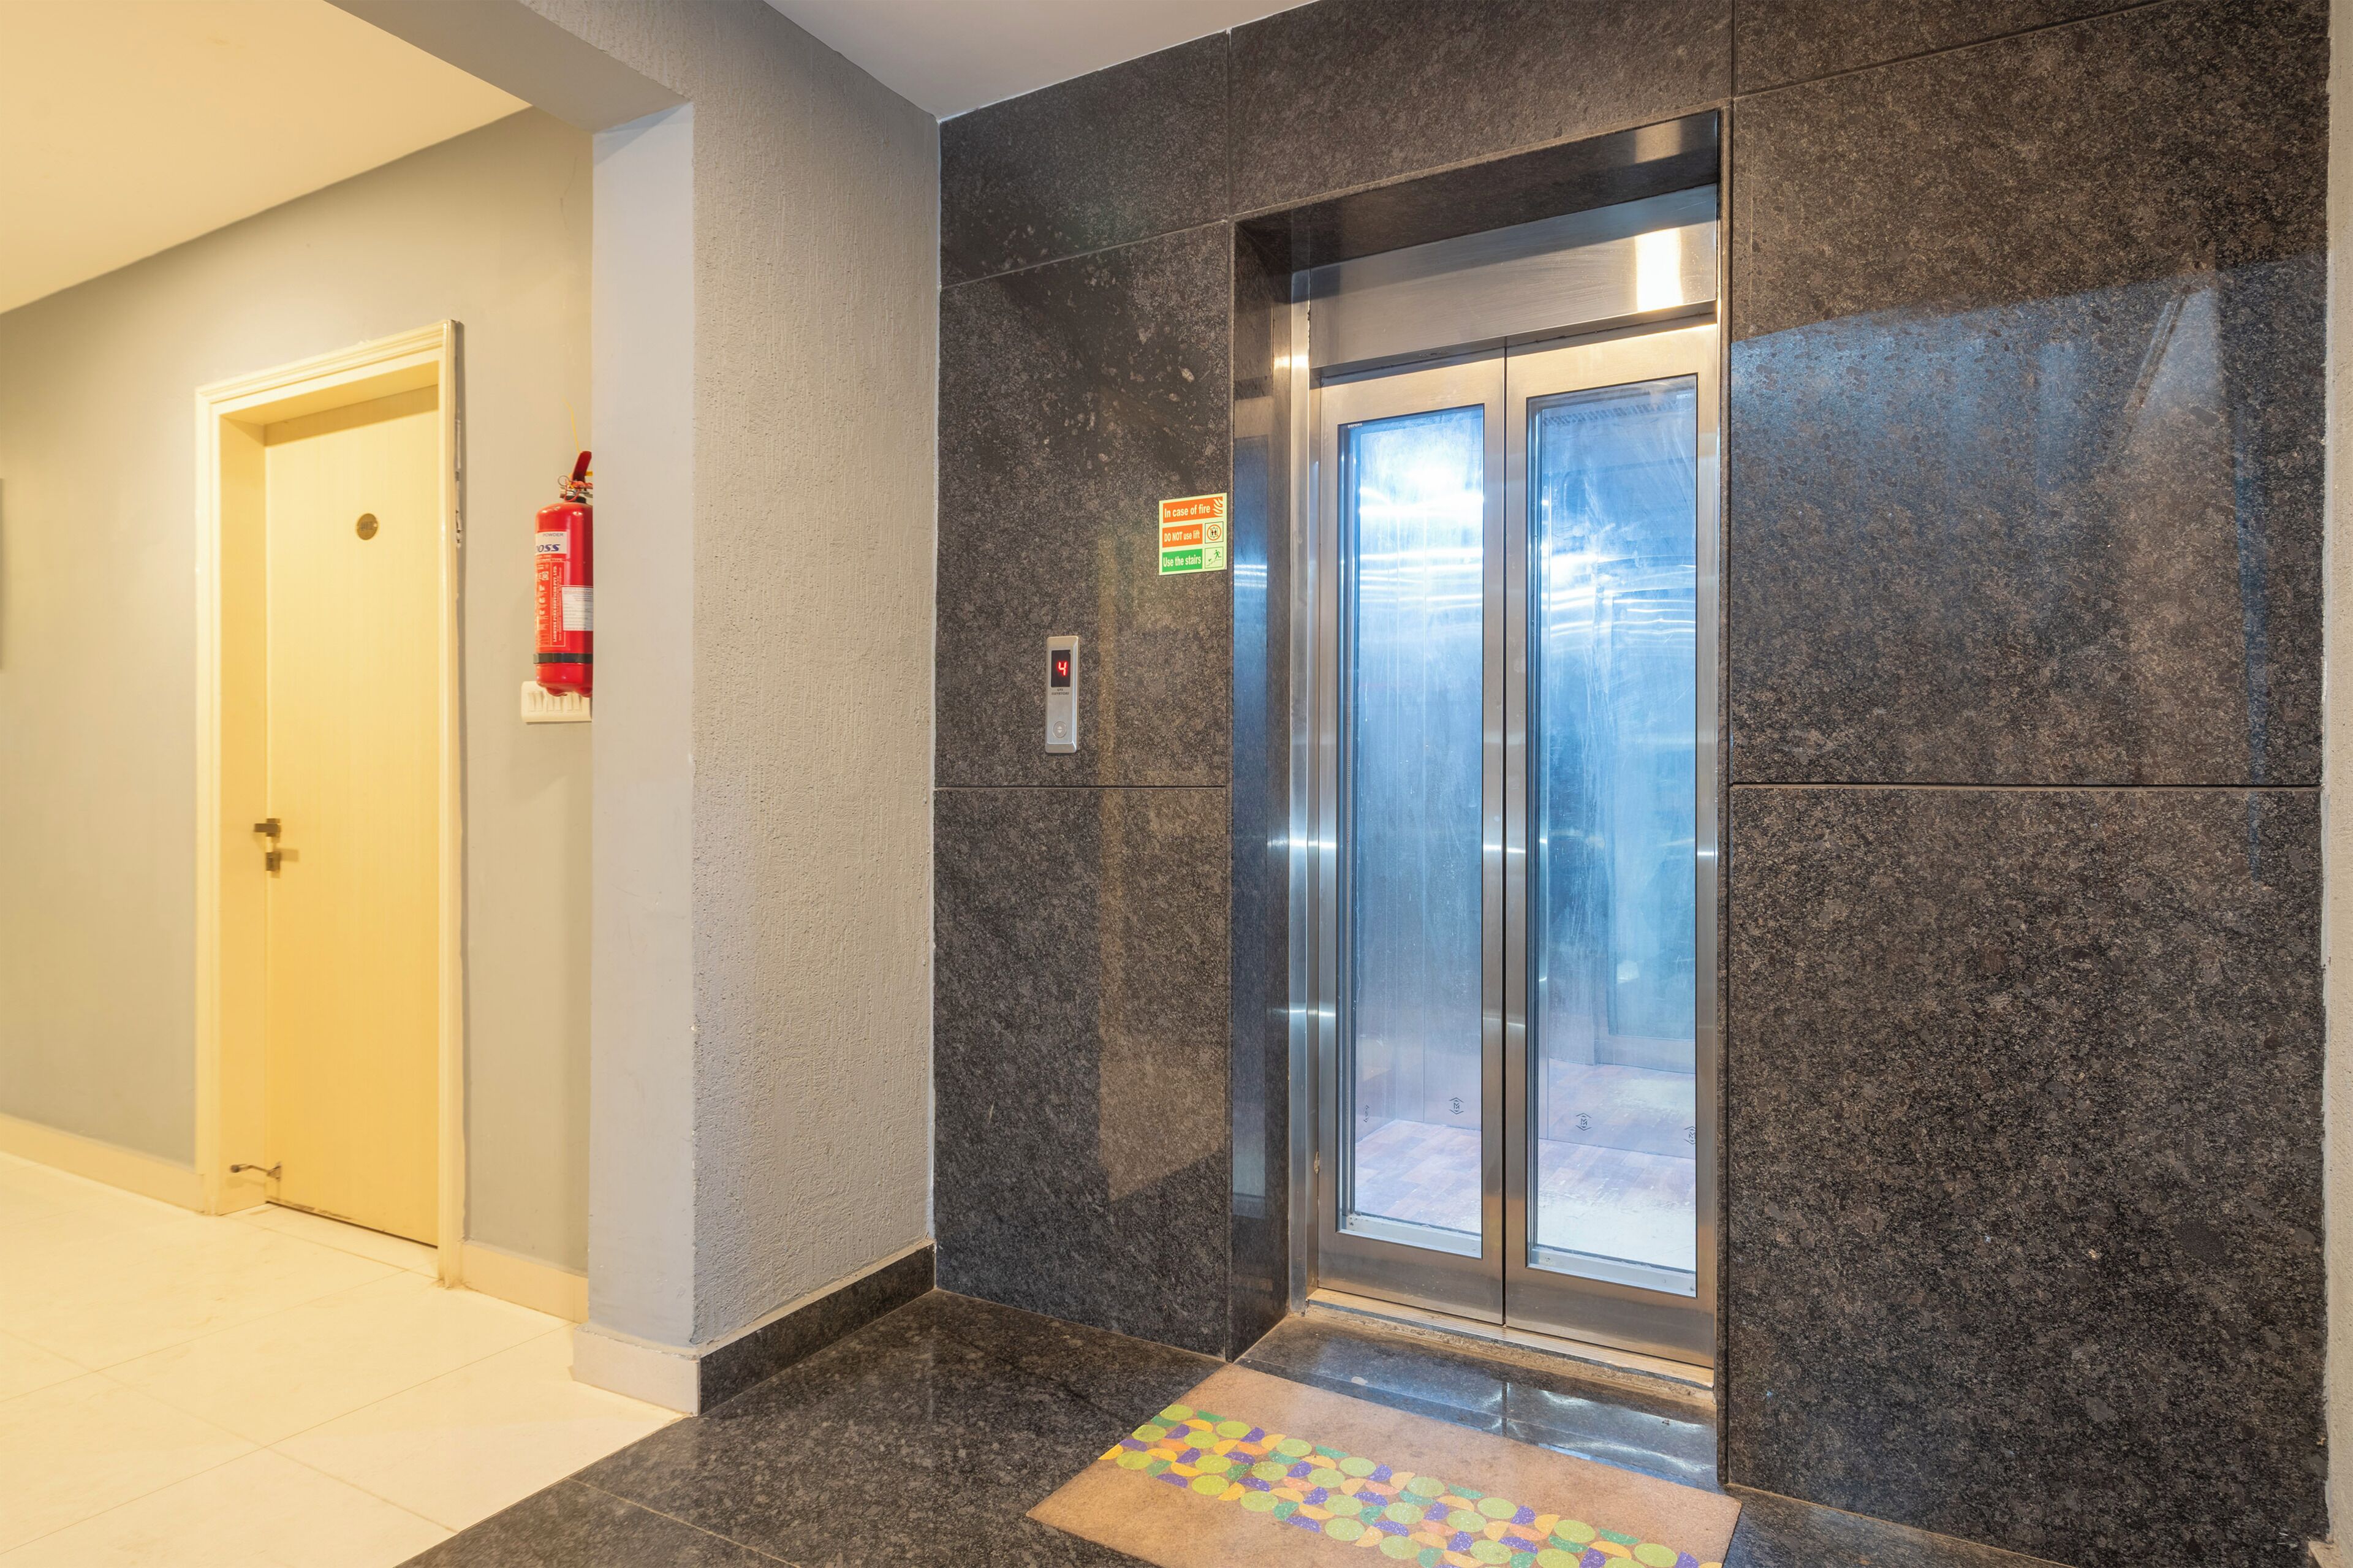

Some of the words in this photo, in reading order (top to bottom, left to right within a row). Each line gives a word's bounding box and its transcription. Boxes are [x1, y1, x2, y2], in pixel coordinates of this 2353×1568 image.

[1164, 508, 1171, 518] In
[1172, 509, 1189, 517] case
[1190, 504, 1197, 515] of
[1199, 504, 1210, 514] fire
[1164, 532, 1172, 542] DO
[1172, 531, 1183, 541] NOT
[1183, 532, 1192, 540] use
[536, 543, 561, 553] OSS
[1163, 557, 1173, 567] Use
[1175, 555, 1184, 566] the
[1185, 554, 1201, 566] stairs
[1058, 661, 1067, 676] 4
